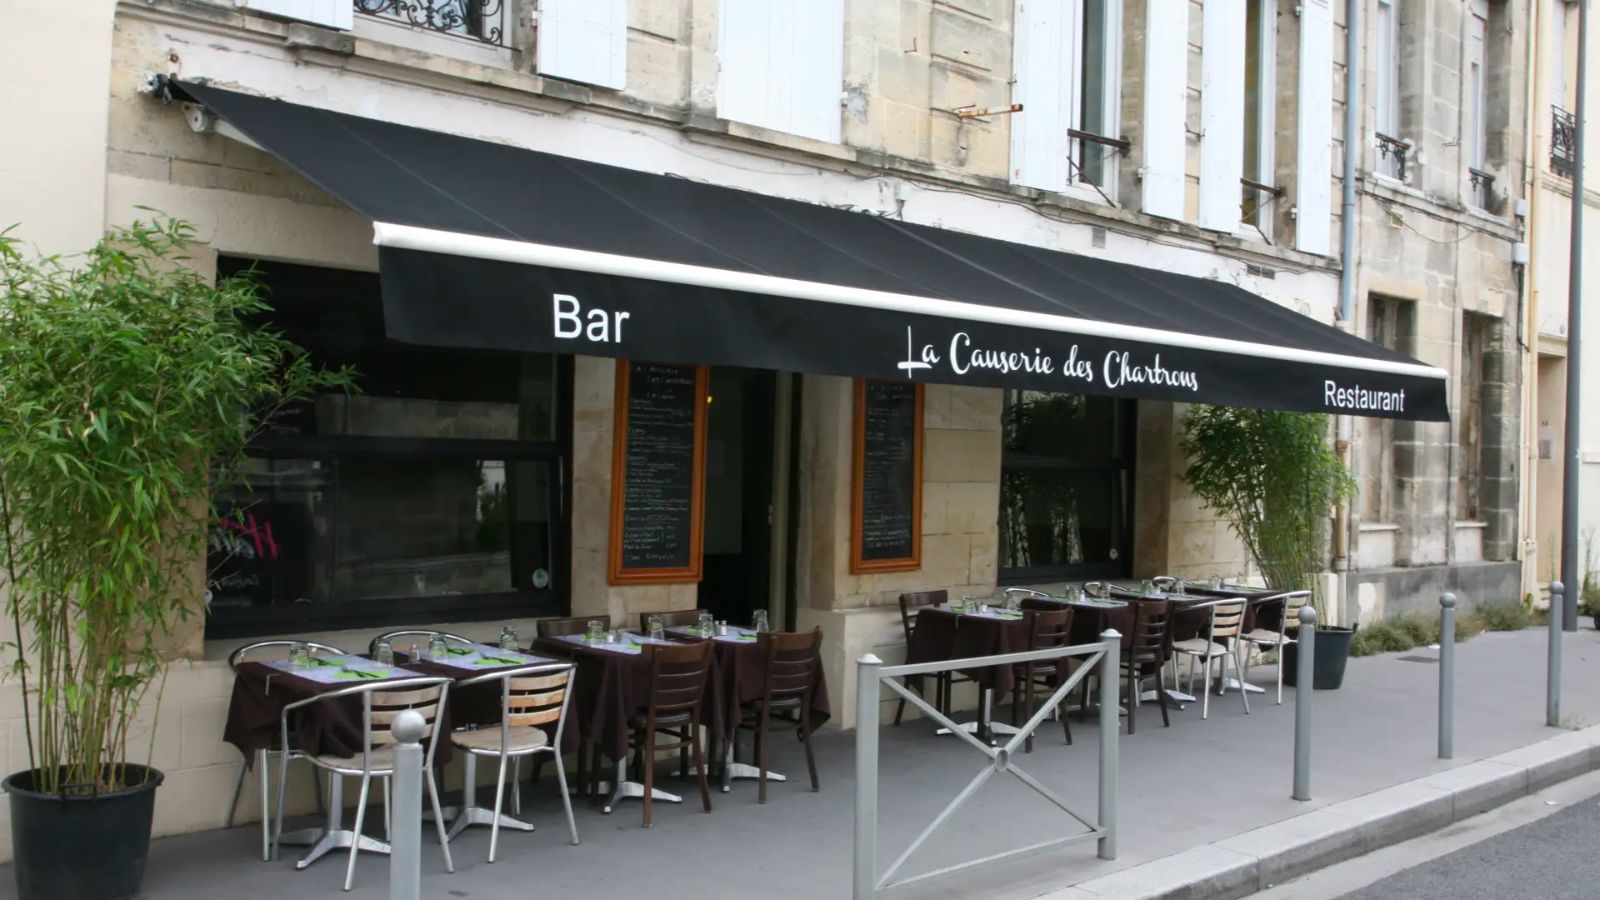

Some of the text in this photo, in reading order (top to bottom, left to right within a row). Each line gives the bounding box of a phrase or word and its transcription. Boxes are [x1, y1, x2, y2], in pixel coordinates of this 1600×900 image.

[552, 293, 631, 344] Bar
[896, 325, 1199, 392] La Causerie des Chartrons
[1324, 379, 1406, 412] Restaurant
